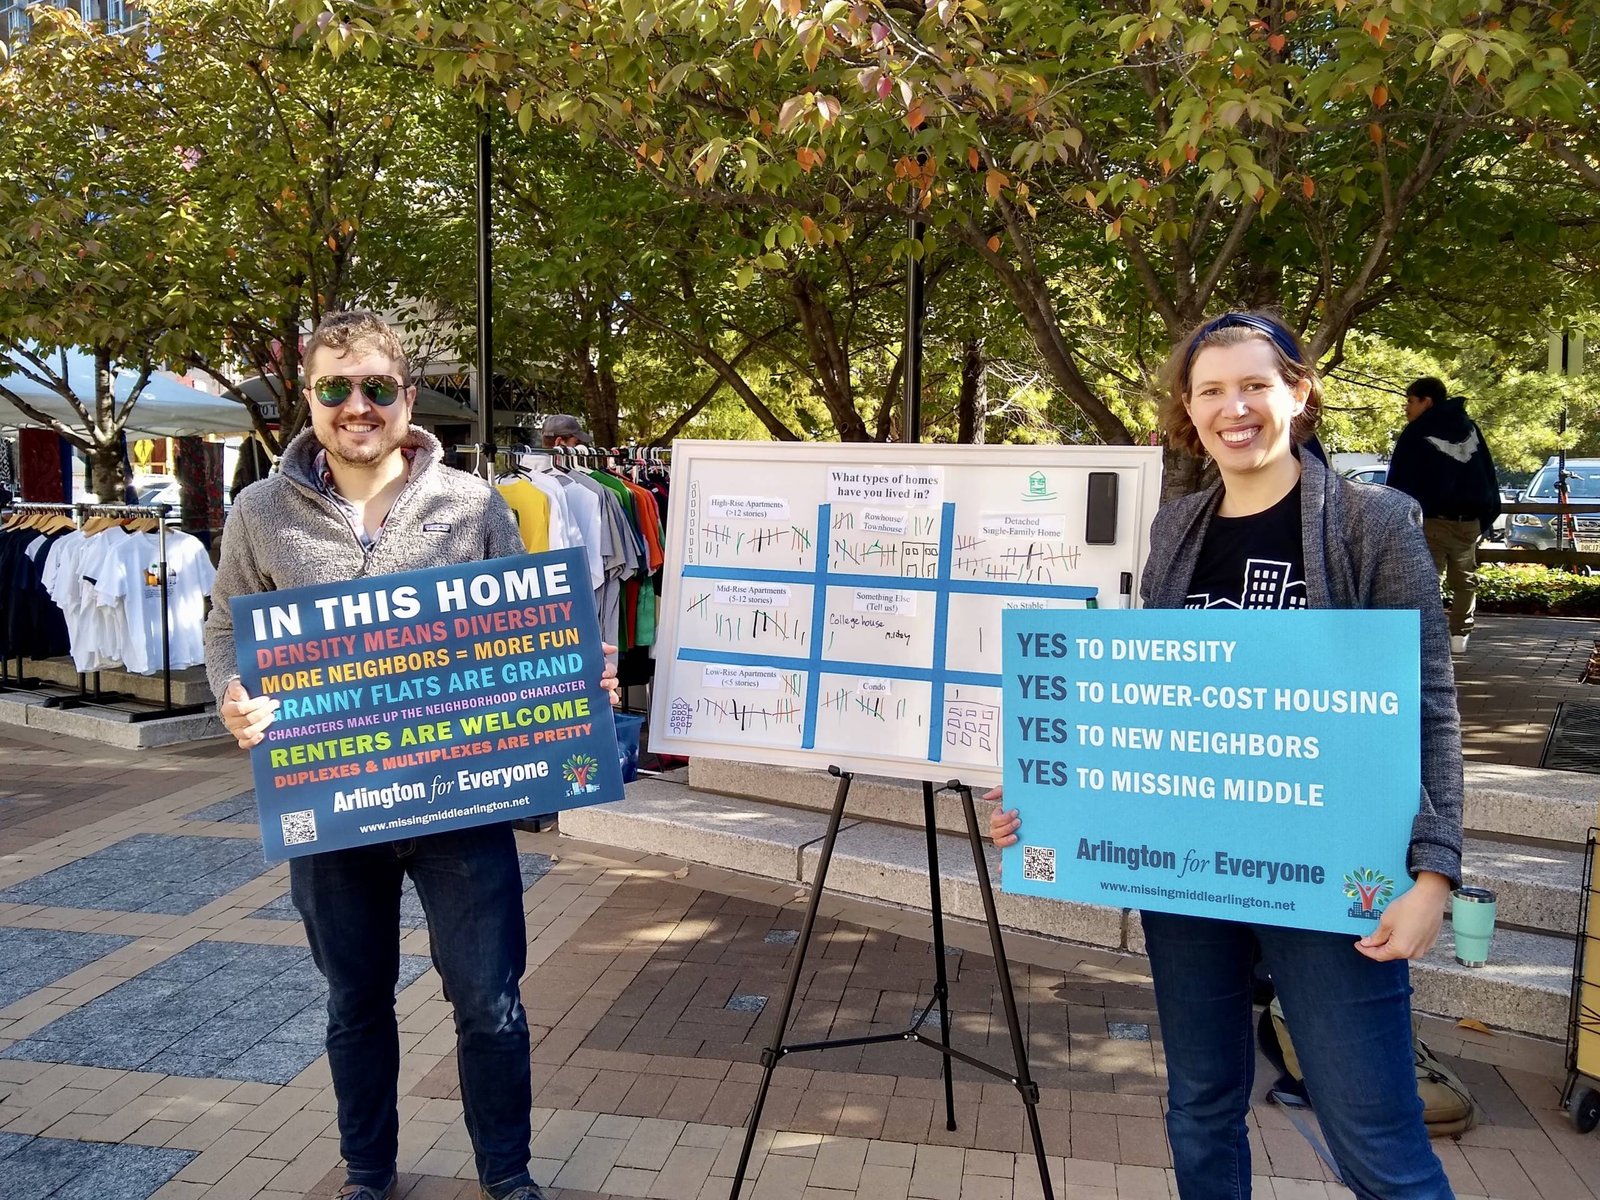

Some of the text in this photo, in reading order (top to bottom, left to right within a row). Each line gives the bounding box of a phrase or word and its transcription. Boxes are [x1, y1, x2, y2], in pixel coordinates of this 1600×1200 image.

[832, 472, 938, 485] What types of homes
[711, 499, 744, 507] High-Rise
[838, 487, 930, 499] have you lived in?
[743, 510, 767, 518] stories)
[865, 512, 904, 523] Rowhouse/
[1004, 517, 1040, 526] Detached
[864, 522, 902, 533] Townhouse
[983, 527, 1061, 537] Single-Family Home
[717, 585, 786, 595] Mid-Rise Apartments
[729, 595, 772, 604] (5-12 stories)
[857, 592, 910, 603] Something Else
[252, 563, 572, 642] IN THIS HOME
[829, 613, 885, 629] College house
[256, 602, 573, 670] DENSITY MEANS DIVERSITY
[1017, 632, 1237, 663] YES TO DIVERSITY
[261, 628, 580, 694] MORE NEIGHBORS = MORE FUN
[371, 676, 443, 706] FLATS
[449, 666, 496, 694] ARE
[501, 653, 583, 683] GRAND
[705, 668, 776, 678] Low-Rise Apartments
[735, 680, 759, 688] stories)
[863, 682, 886, 690] Condo
[1017, 675, 1399, 716] YES TO LOWER-COST HOUSING
[268, 680, 586, 742] CHARACTERS MAKE UP THE NEIGHBORHOOD CHARACTER
[270, 698, 590, 769] RENTERS ARE WELCOME
[1017, 716, 1320, 759] YES TO NEW NEIGHBORS
[274, 724, 592, 788] DUPLEXES & MULTIPLEXES ARE PRETTY
[333, 760, 549, 813] Arlington for Everyone
[1017, 759, 1325, 807] YES TO MISSING MIDDLE
[360, 796, 530, 834] www.missingmiddlearlington.net
[1076, 838, 1325, 885] Arlington for Everyone
[1100, 880, 1296, 912] www.missingmiddlearlington.net
